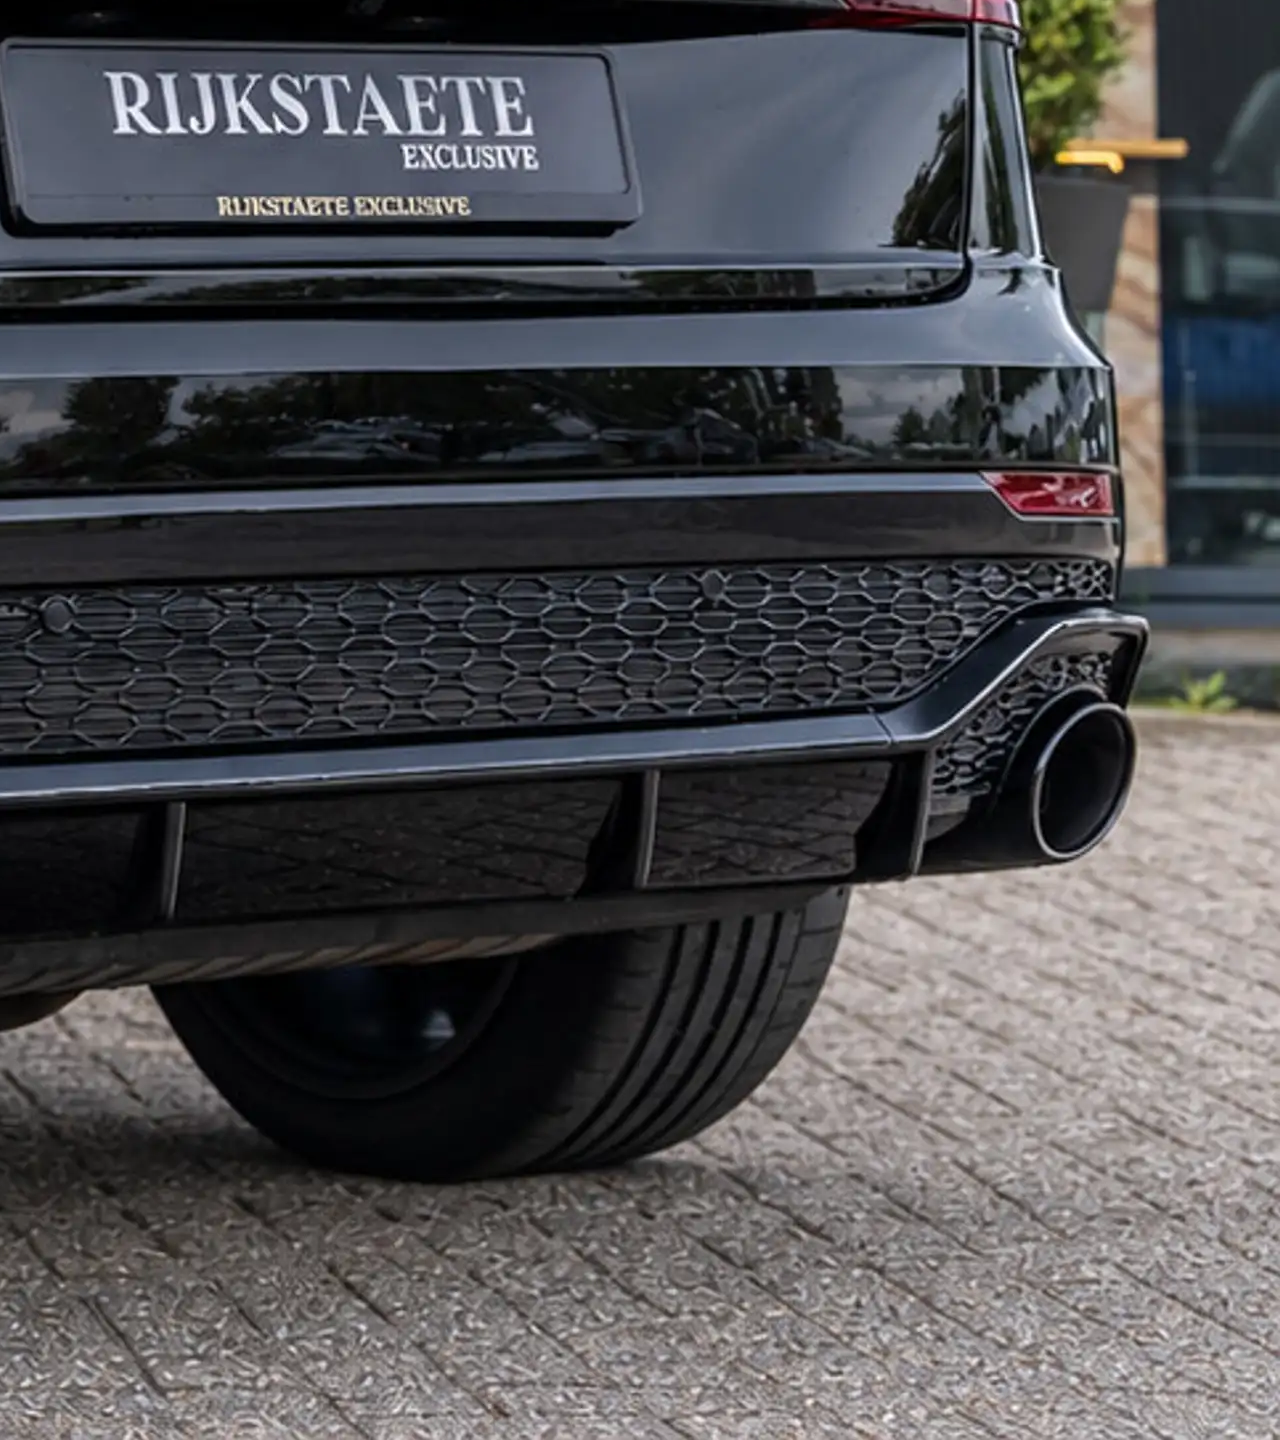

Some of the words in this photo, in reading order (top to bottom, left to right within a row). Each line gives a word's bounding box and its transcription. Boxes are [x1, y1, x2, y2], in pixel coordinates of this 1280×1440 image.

[104, 71, 534, 137] RIJKSTAETE
[401, 144, 540, 170] EXCLUSIVE
[217, 195, 351, 217] RIJKSTAETE
[354, 195, 472, 217] EXCLUSIVE
